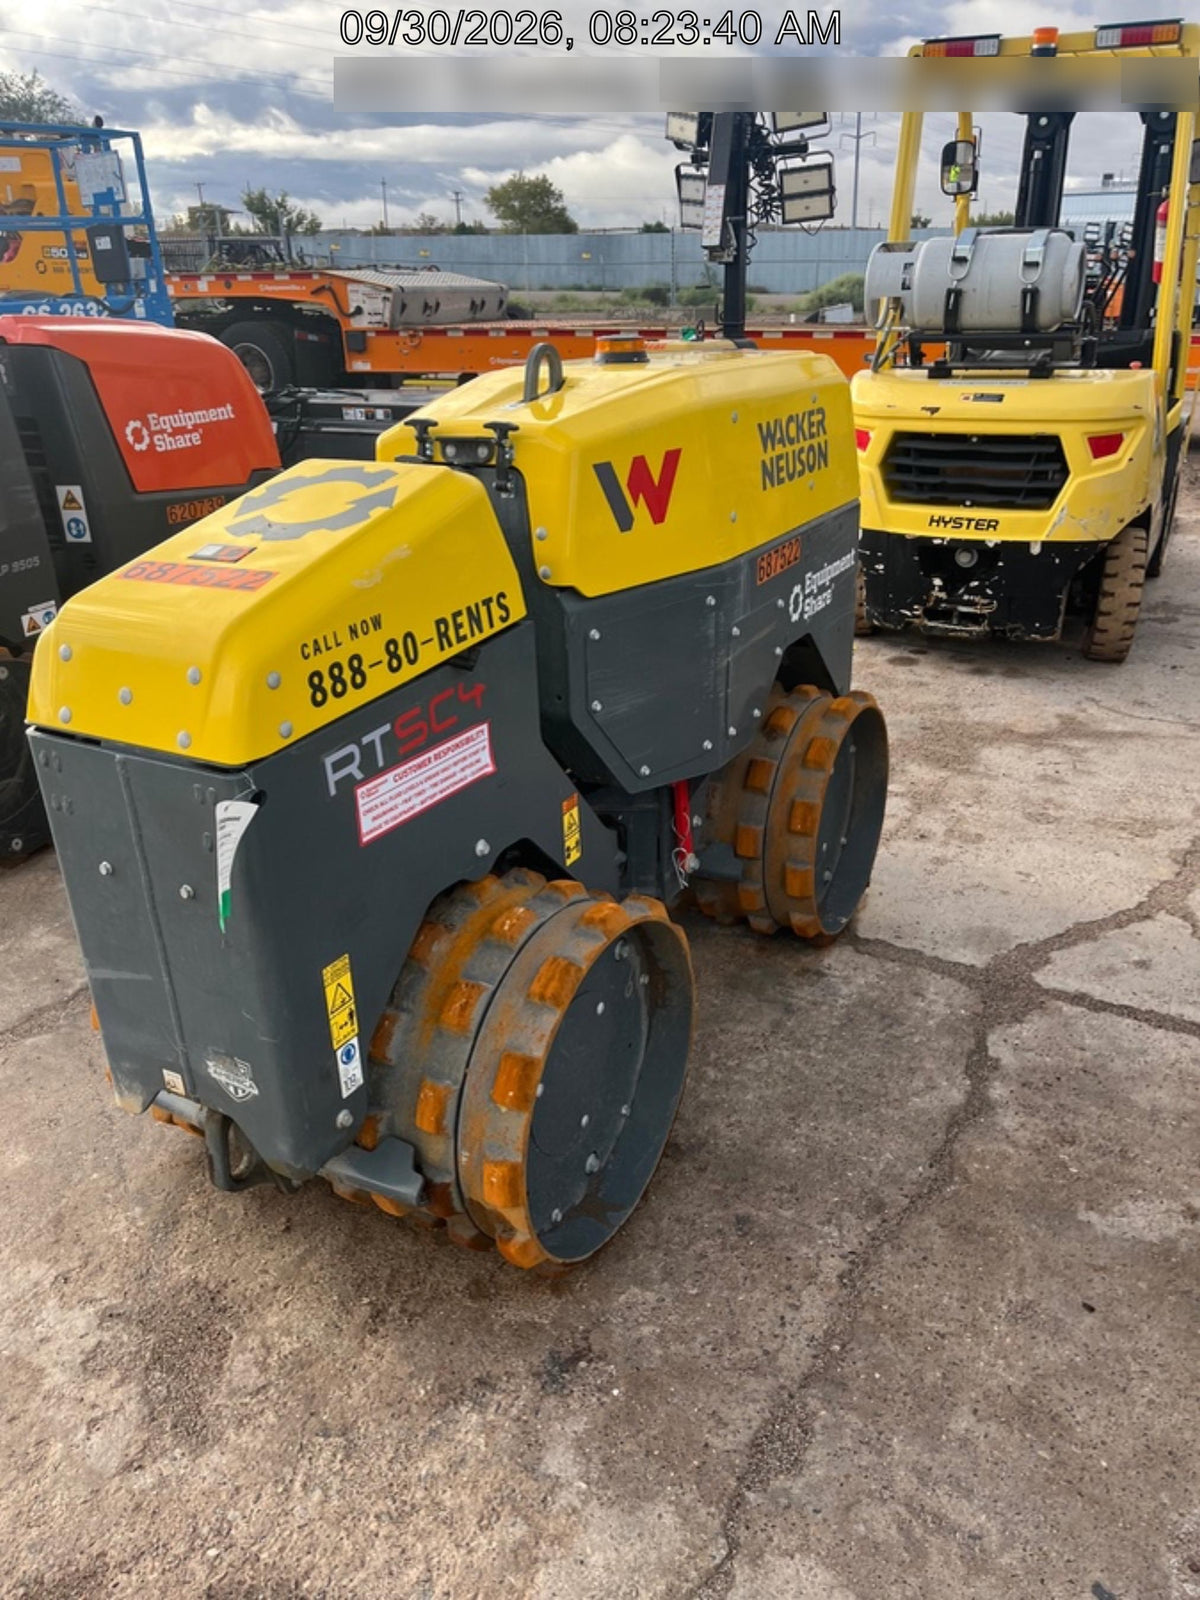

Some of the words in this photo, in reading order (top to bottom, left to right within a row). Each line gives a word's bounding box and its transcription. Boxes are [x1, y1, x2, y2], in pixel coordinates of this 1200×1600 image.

[147, 402, 235, 432] Equipment
[757, 407, 827, 453] WACKER
[152, 431, 202, 452] Share
[761, 440, 828, 491] NEUSON
[928, 514, 1000, 532] HYSTER
[123, 561, 275, 590] 687522
[758, 538, 800, 582] 687522
[805, 548, 856, 594] Equipment
[803, 588, 833, 620] Share
[300, 631, 342, 661] CALL
[348, 613, 383, 640] NOW
[307, 591, 511, 708] 888-80-RENTS
[392, 756, 432, 783] CUSTOMER
